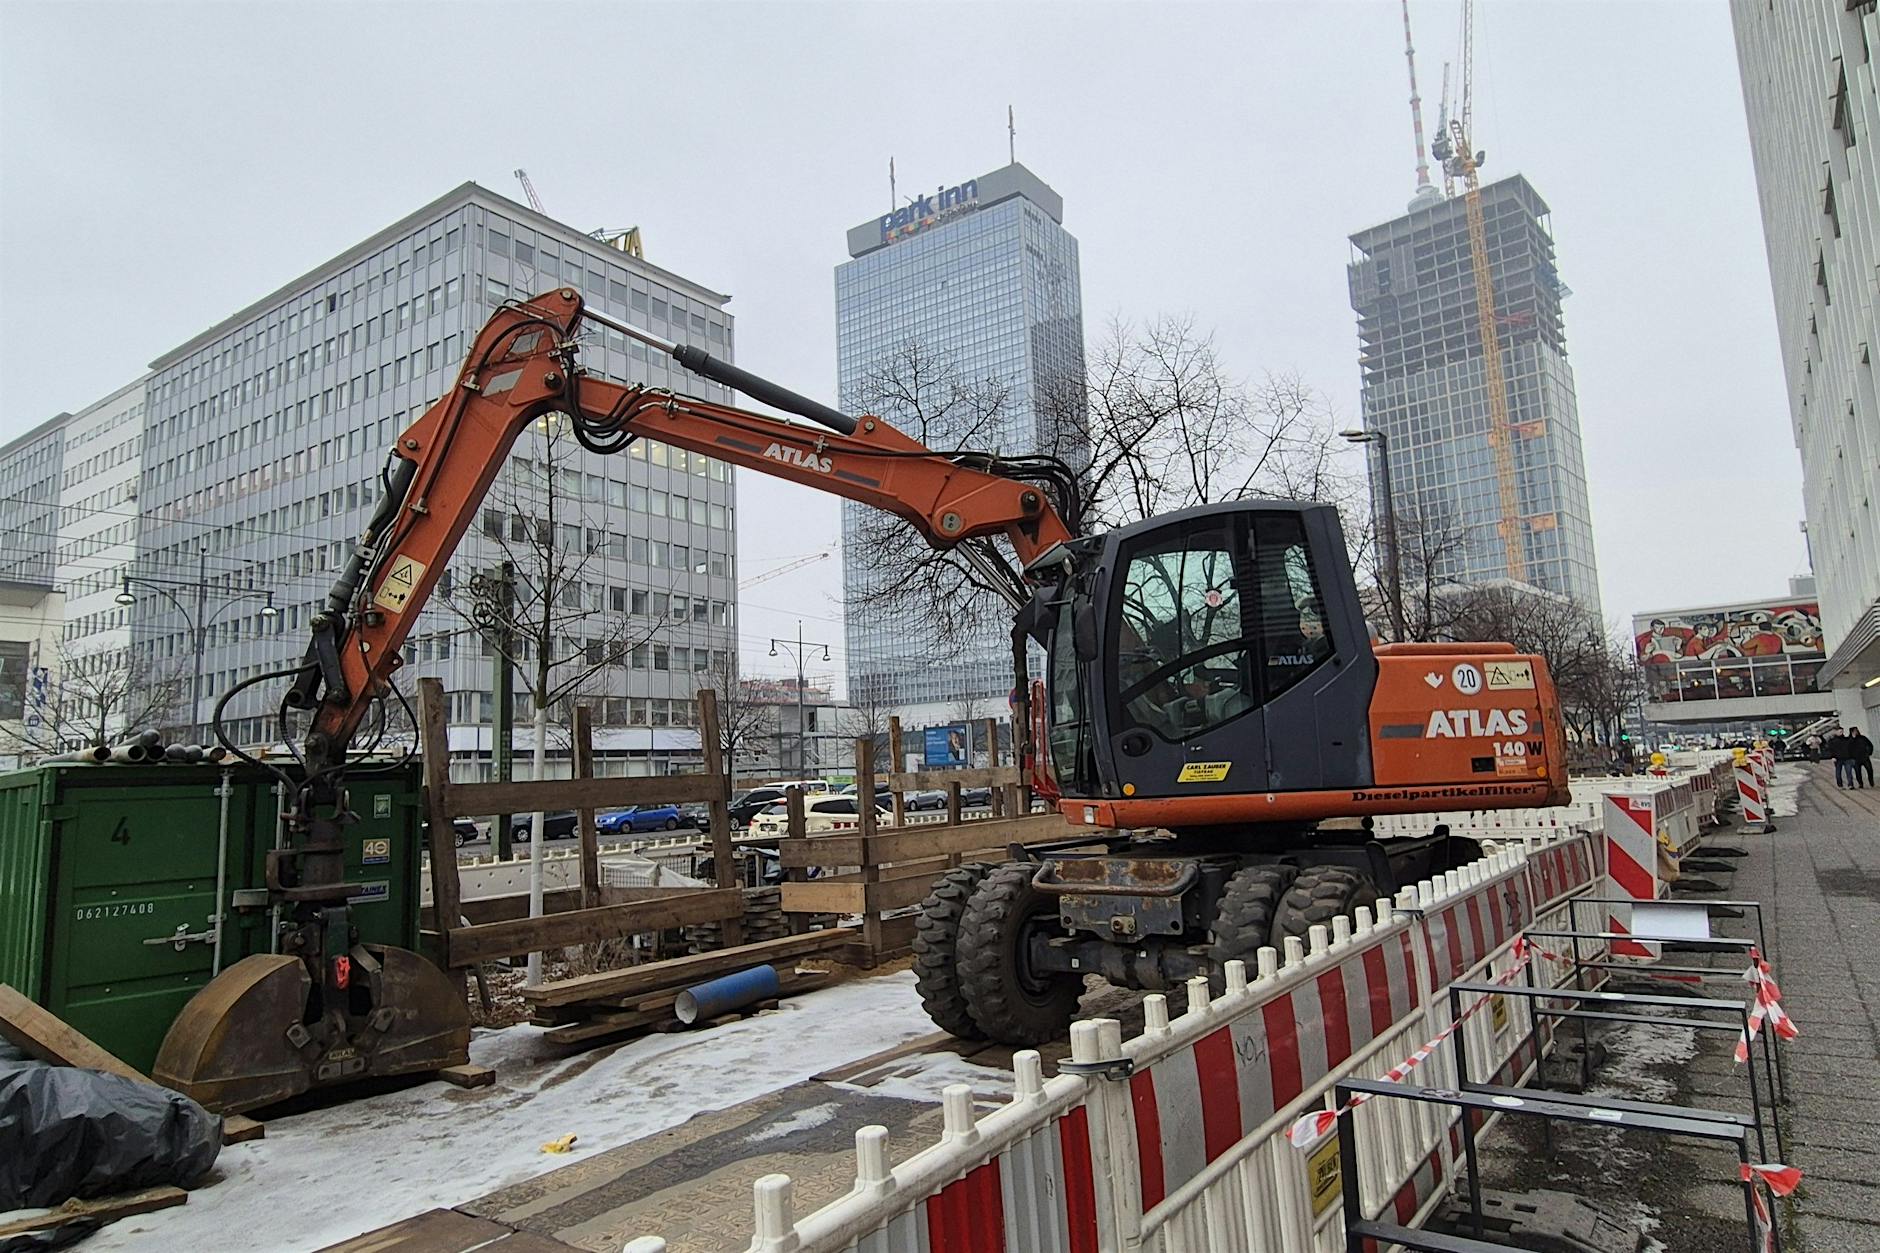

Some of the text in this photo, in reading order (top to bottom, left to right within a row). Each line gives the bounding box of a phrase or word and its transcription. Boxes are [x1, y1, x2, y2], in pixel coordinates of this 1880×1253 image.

[880, 194, 934, 240] park
[938, 179, 978, 210] inn
[763, 442, 833, 473] ATLAS
[1278, 654, 1314, 665] ATLAS
[1457, 669, 1476, 688] 20
[1425, 709, 1528, 738] ATLAS
[111, 816, 130, 845] 4
[77, 903, 154, 920] 062127408
